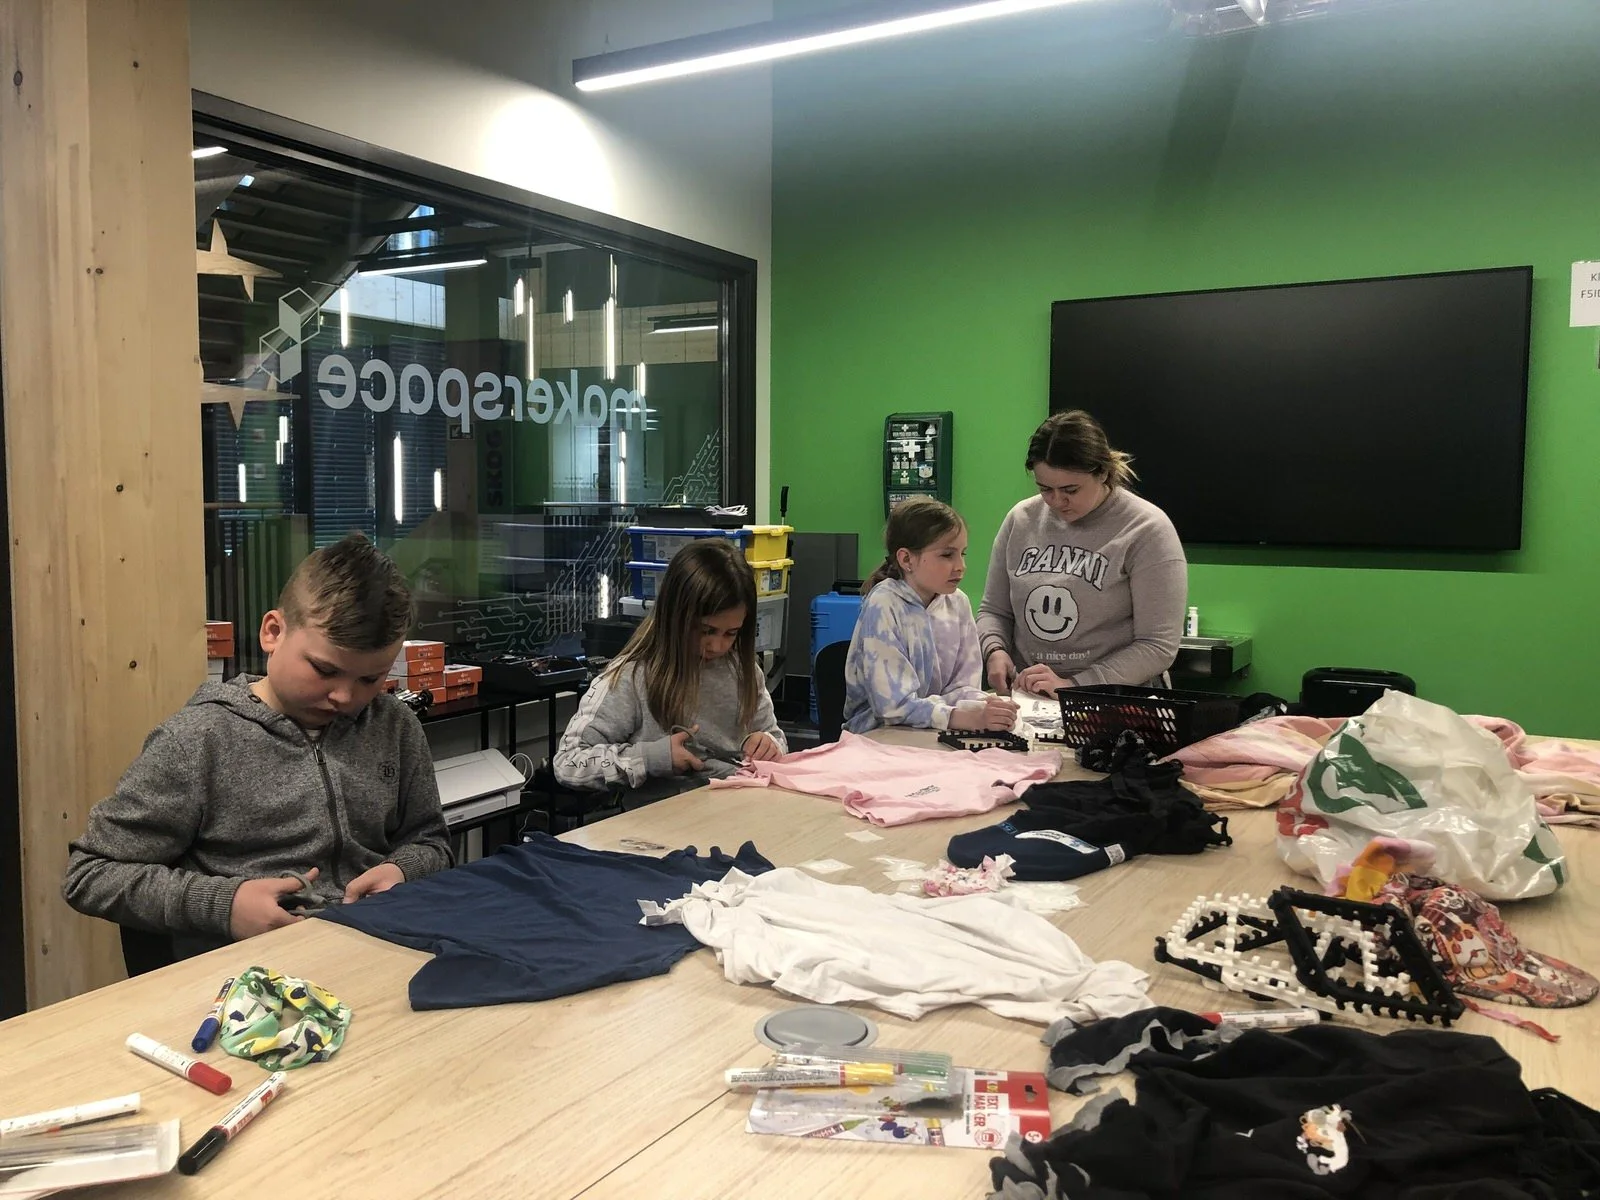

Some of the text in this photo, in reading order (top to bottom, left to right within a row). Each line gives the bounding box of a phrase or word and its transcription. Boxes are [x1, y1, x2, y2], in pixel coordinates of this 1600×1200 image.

[1591, 273, 1600, 281] K
[486, 428, 503, 507] SKOG
[1014, 544, 1109, 591] GANNI
[1046, 650, 1067, 660] nice
